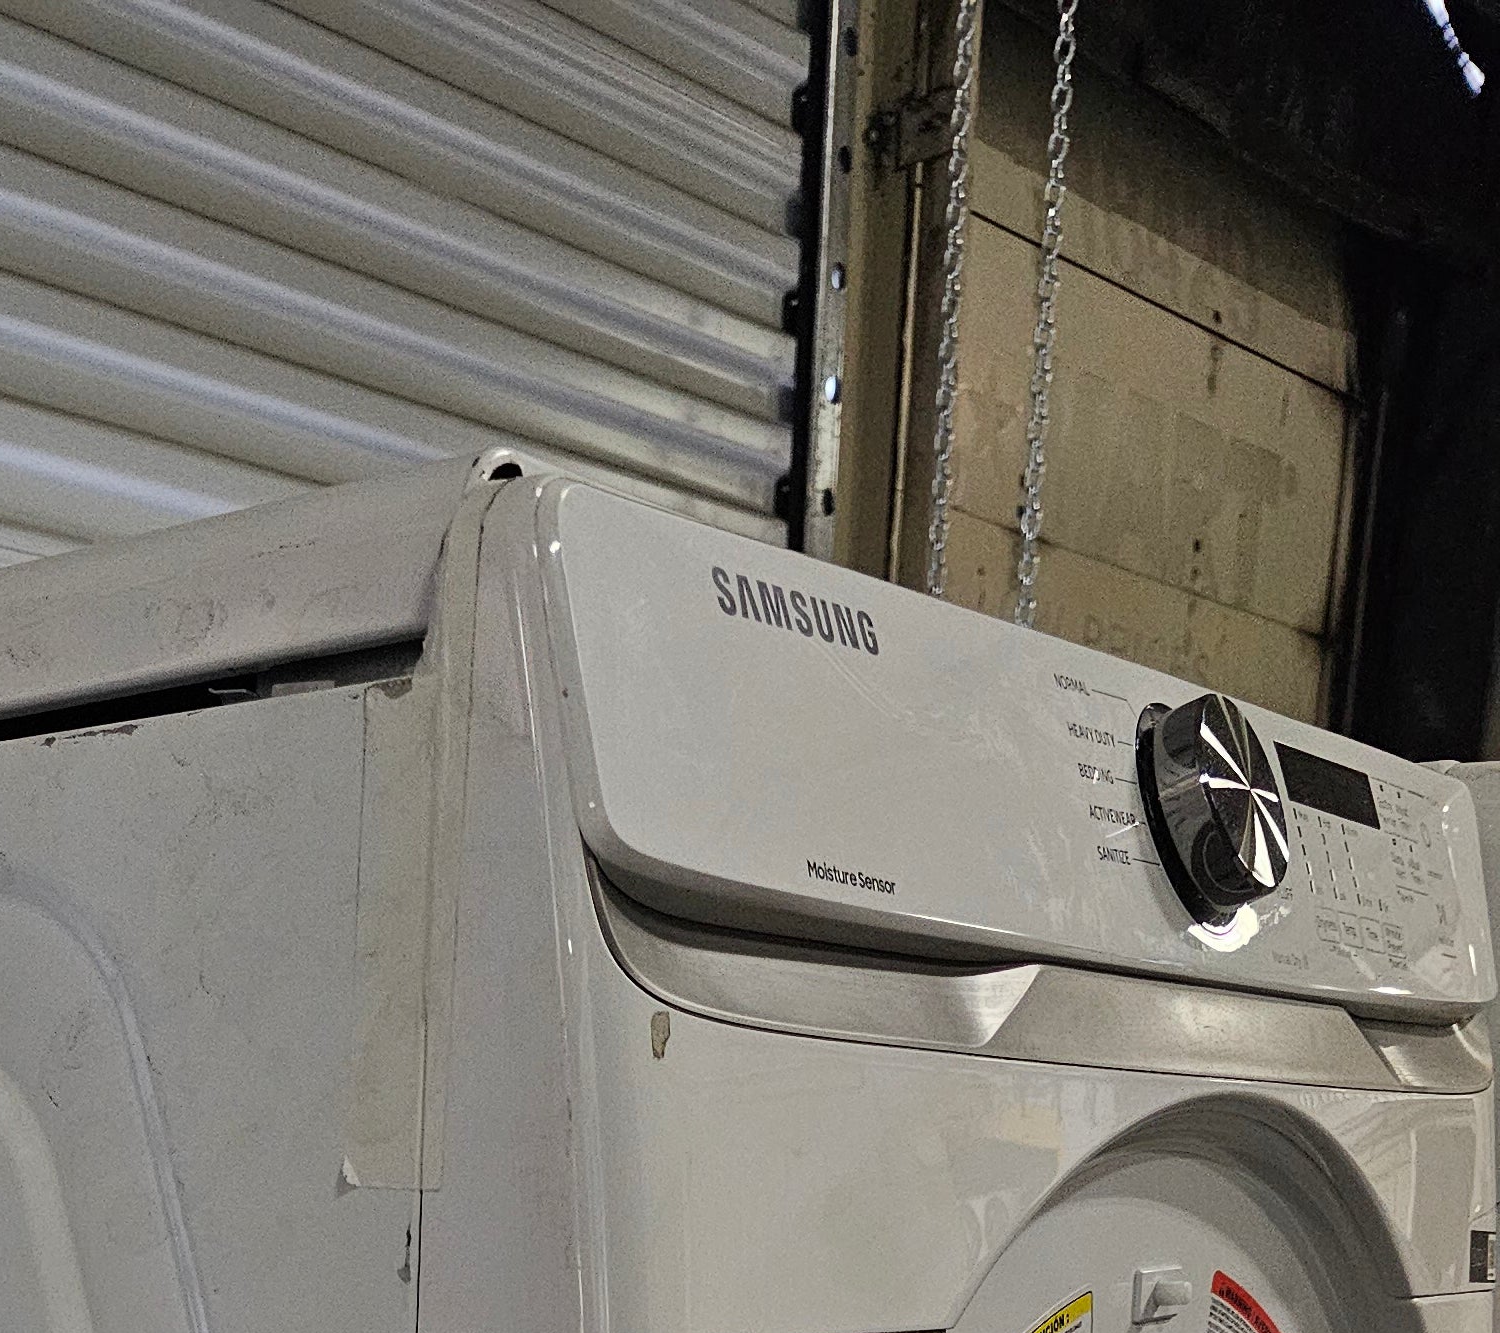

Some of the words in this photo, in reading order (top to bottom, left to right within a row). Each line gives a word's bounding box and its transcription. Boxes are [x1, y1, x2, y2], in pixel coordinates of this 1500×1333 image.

[711, 565, 880, 656] SAMSUNG
[1052, 672, 1091, 697] NORMAL
[1066, 720, 1094, 743] HEAVY
[1094, 729, 1116, 748] DUTY
[1088, 804, 1138, 828] ACTIVEWEAR
[1096, 845, 1131, 866] SANITIZE
[806, 858, 858, 887] Moisture
[857, 871, 896, 895] Sensor
